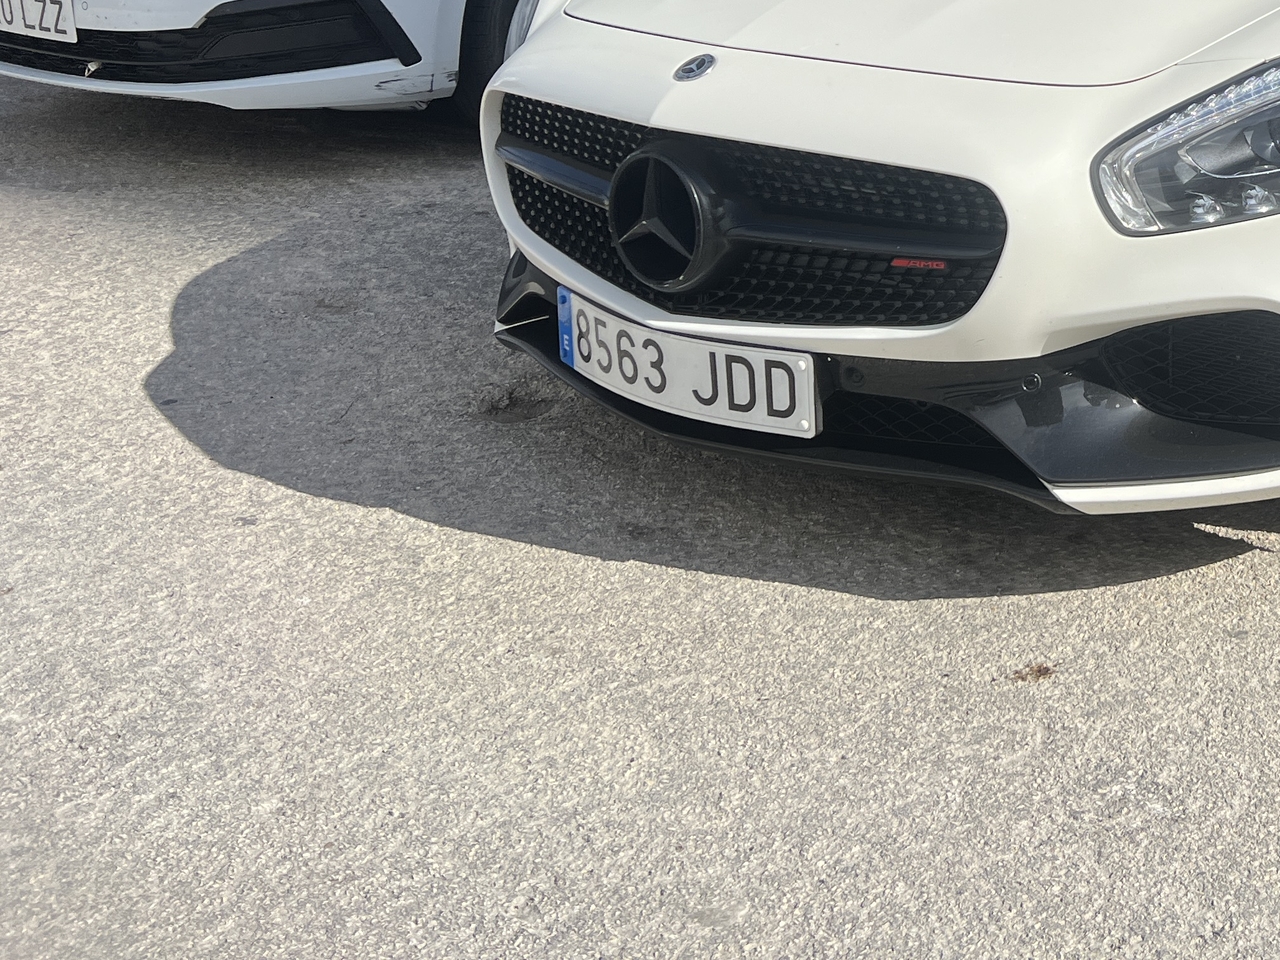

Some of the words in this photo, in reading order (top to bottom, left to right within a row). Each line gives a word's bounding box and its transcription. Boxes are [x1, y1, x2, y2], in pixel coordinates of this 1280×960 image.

[907, 260, 945, 269] AMG
[576, 308, 667, 394] 8563
[692, 351, 797, 419] JDD
